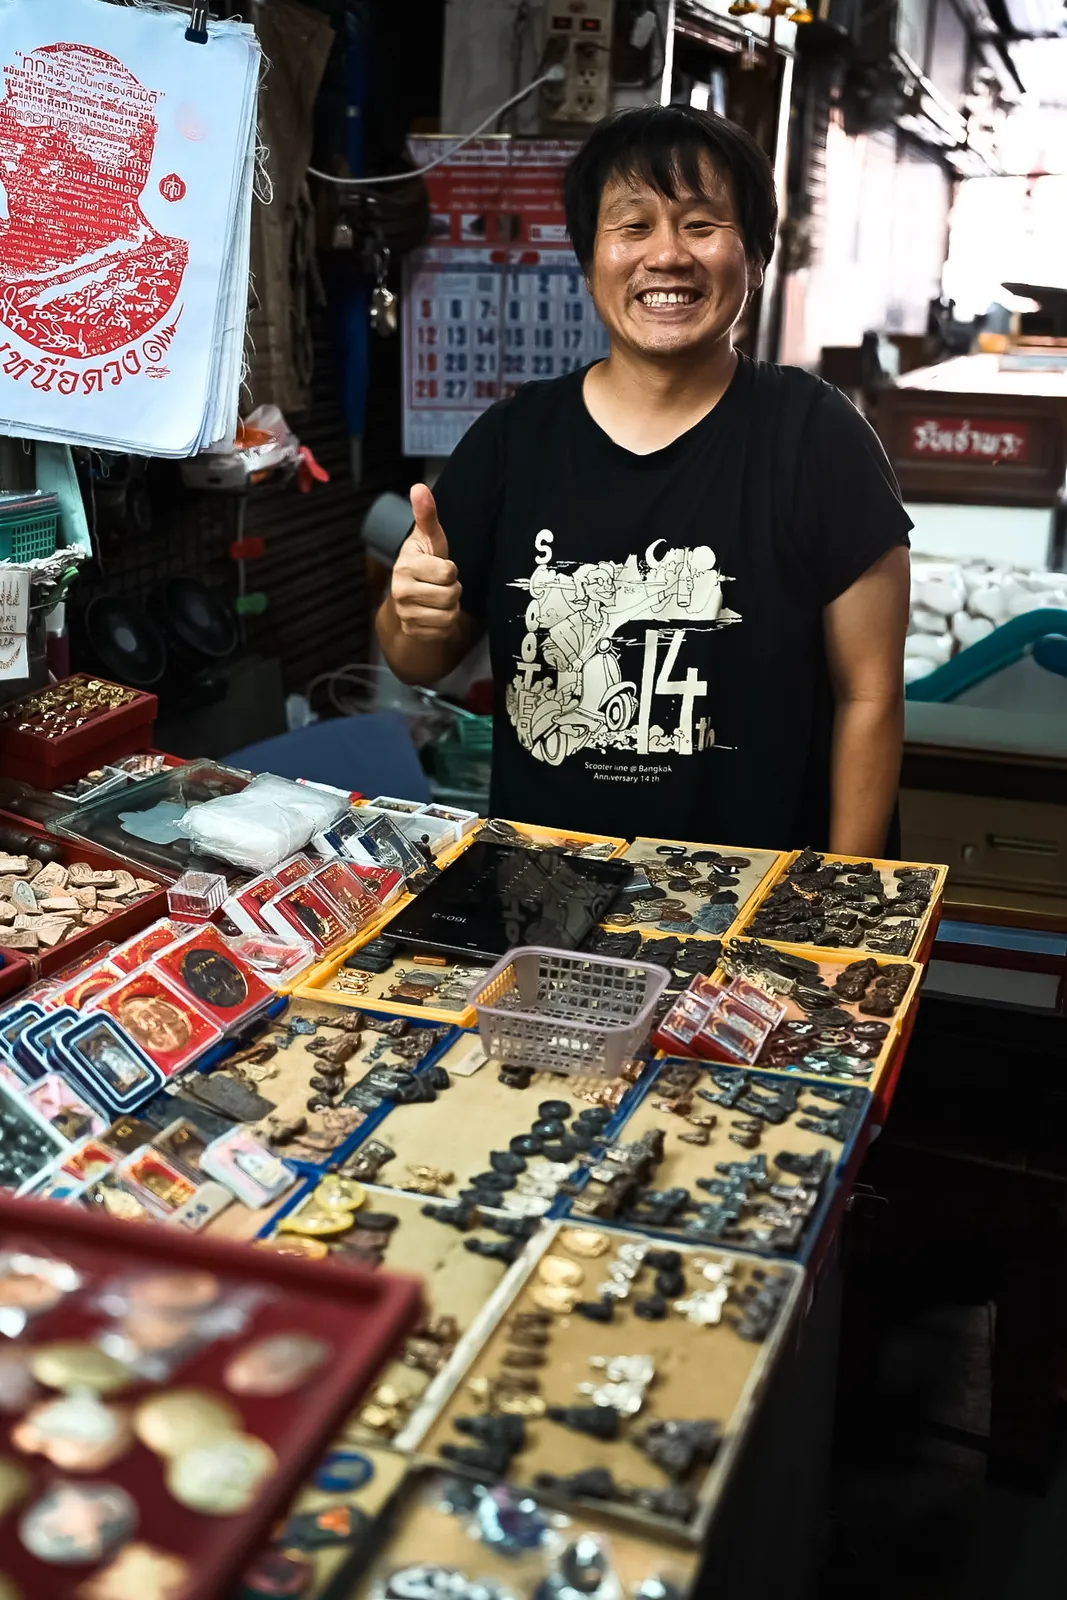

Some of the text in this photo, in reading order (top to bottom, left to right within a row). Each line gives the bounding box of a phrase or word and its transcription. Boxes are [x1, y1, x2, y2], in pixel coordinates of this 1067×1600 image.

[480, 300, 491, 318] 7
[418, 326, 437, 345] 12
[447, 327, 467, 345] 13
[563, 329, 583, 347] 17
[0, 341, 142, 396] หนือดวง
[475, 354, 496, 371] 21
[445, 379, 467, 398] 27
[584, 761, 613, 770] Scooter
[638, 764, 673, 775] Bangkok
[593, 772, 660, 784] Anniversary 14 th
